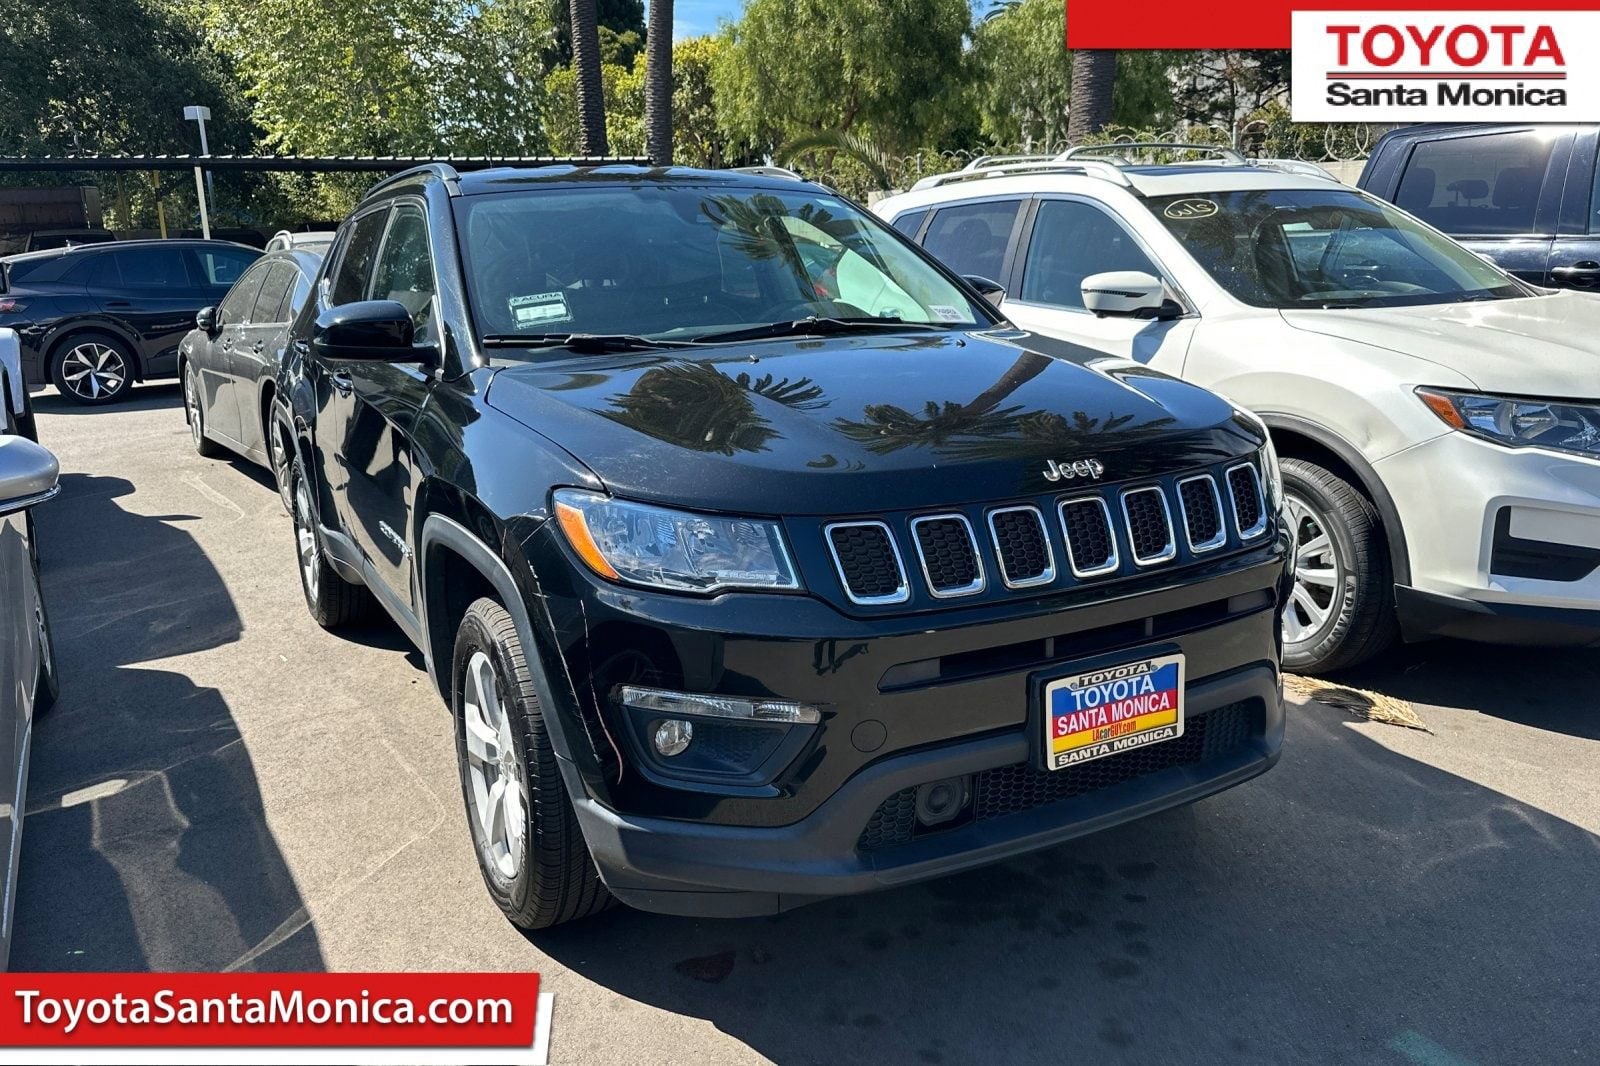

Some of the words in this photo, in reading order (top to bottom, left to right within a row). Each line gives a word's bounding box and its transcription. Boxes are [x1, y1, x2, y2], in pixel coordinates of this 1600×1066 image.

[1043, 459, 1103, 481] Jeep
[1081, 663, 1148, 686] TOYOTA
[1071, 675, 1155, 710] TOYOTA
[1057, 706, 1108, 736] SANTA
[1111, 692, 1170, 722] MONICA
[1092, 720, 1137, 742] LAcarGUY.com
[1058, 744, 1110, 766] SANTA
[1113, 727, 1174, 750] MONICA
